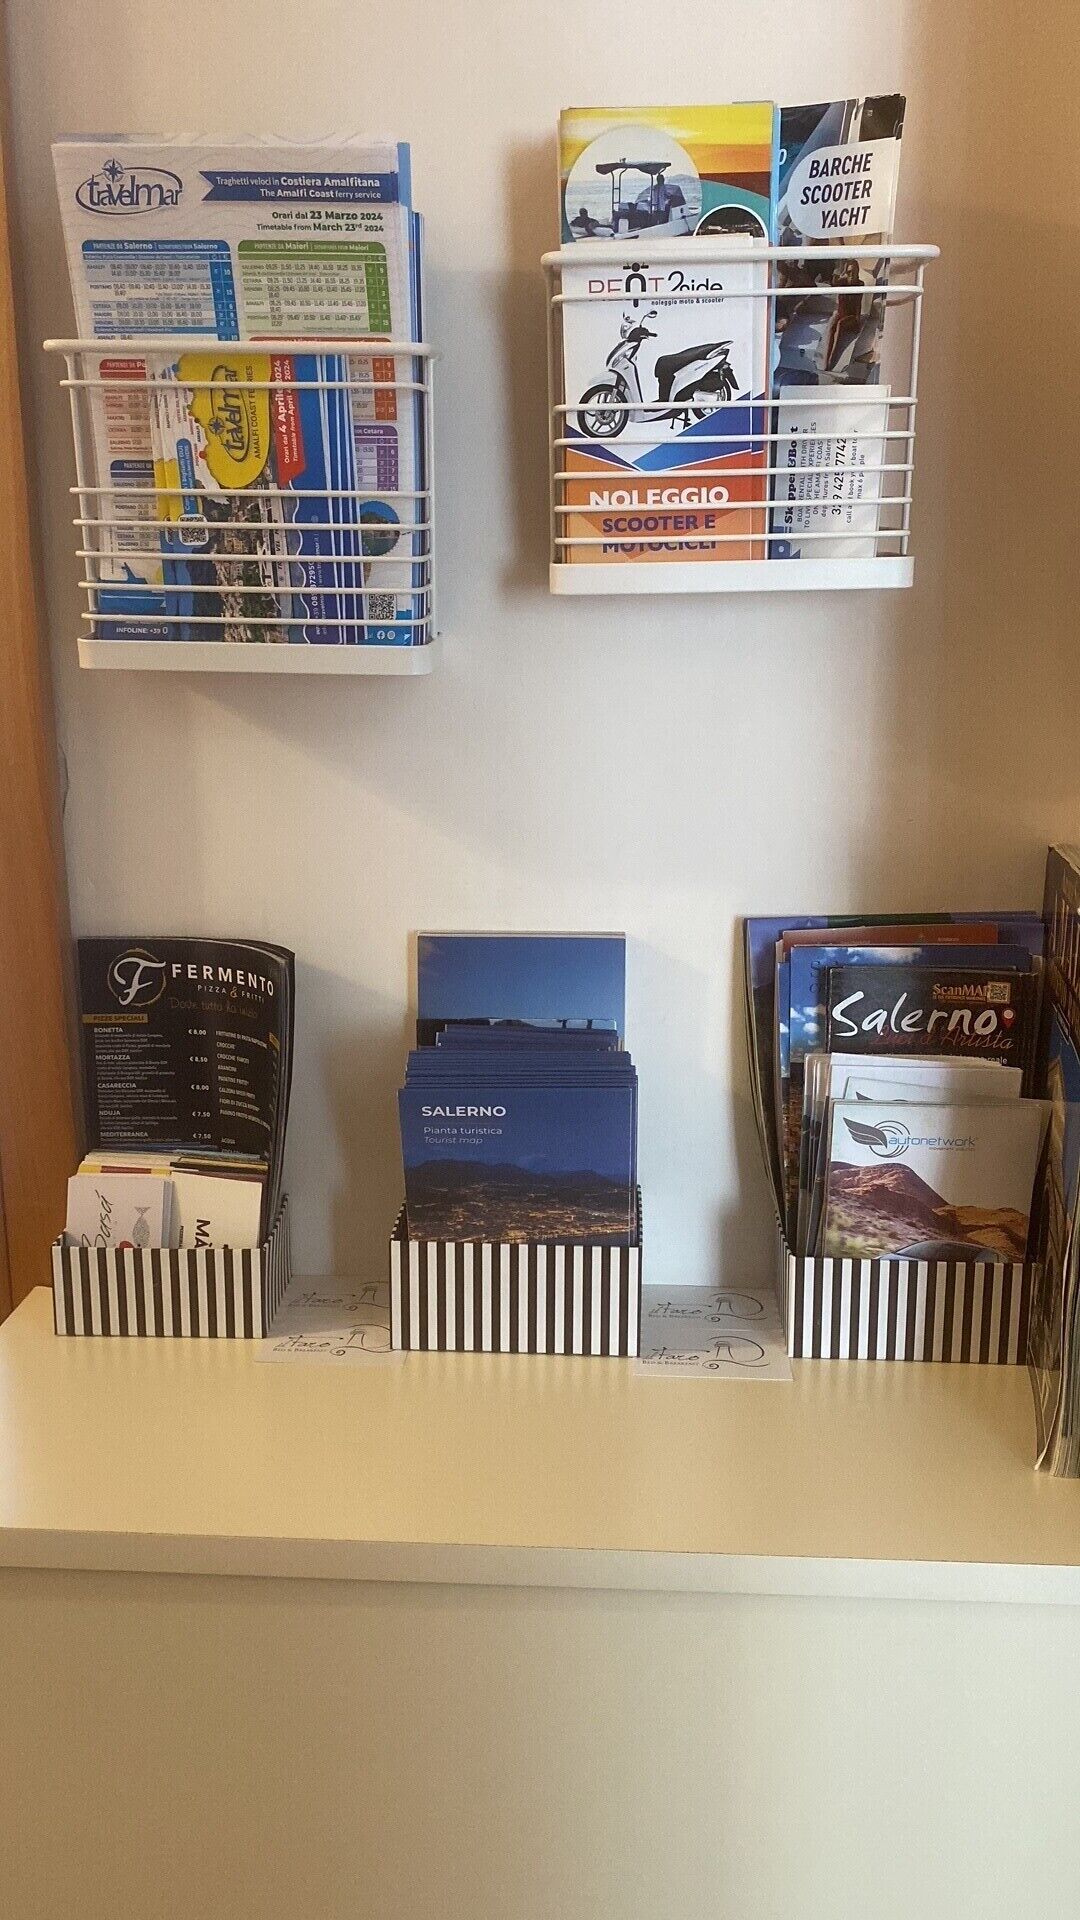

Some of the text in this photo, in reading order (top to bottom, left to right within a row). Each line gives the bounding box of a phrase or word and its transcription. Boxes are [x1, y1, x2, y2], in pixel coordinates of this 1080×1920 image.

[809, 153, 873, 178] BARCHE
[216, 176, 380, 187] Traghetti veloci in Costiera Amalfitana
[260, 188, 381, 199] The Amalfi Coast ferry service
[800, 179, 873, 205] SCOOTER
[272, 211, 384, 221] Orari dal 23 Marzo 2024
[821, 206, 871, 229] YACHT
[256, 223, 293, 231] Timetable
[313, 223, 342, 232] March
[286, 242, 309, 250] Maiori
[651, 299, 678, 307] noleggio
[250, 401, 258, 428] COAST
[253, 429, 261, 459] AMALFI
[835, 438, 846, 466] 7742
[589, 486, 730, 507] NOLEGGIO
[602, 514, 716, 533] SCOOTER E
[172, 963, 274, 997] FERMENTO
[197, 984, 227, 994] PIZZA
[241, 990, 264, 1003] FRITTI
[832, 990, 998, 1037] Salerno
[421, 1106, 507, 1117] SALERNO
[424, 1126, 503, 1135] Pianta turistica
[424, 1136, 456, 1144] Tourist
[888, 1136, 976, 1147] autonetwork
